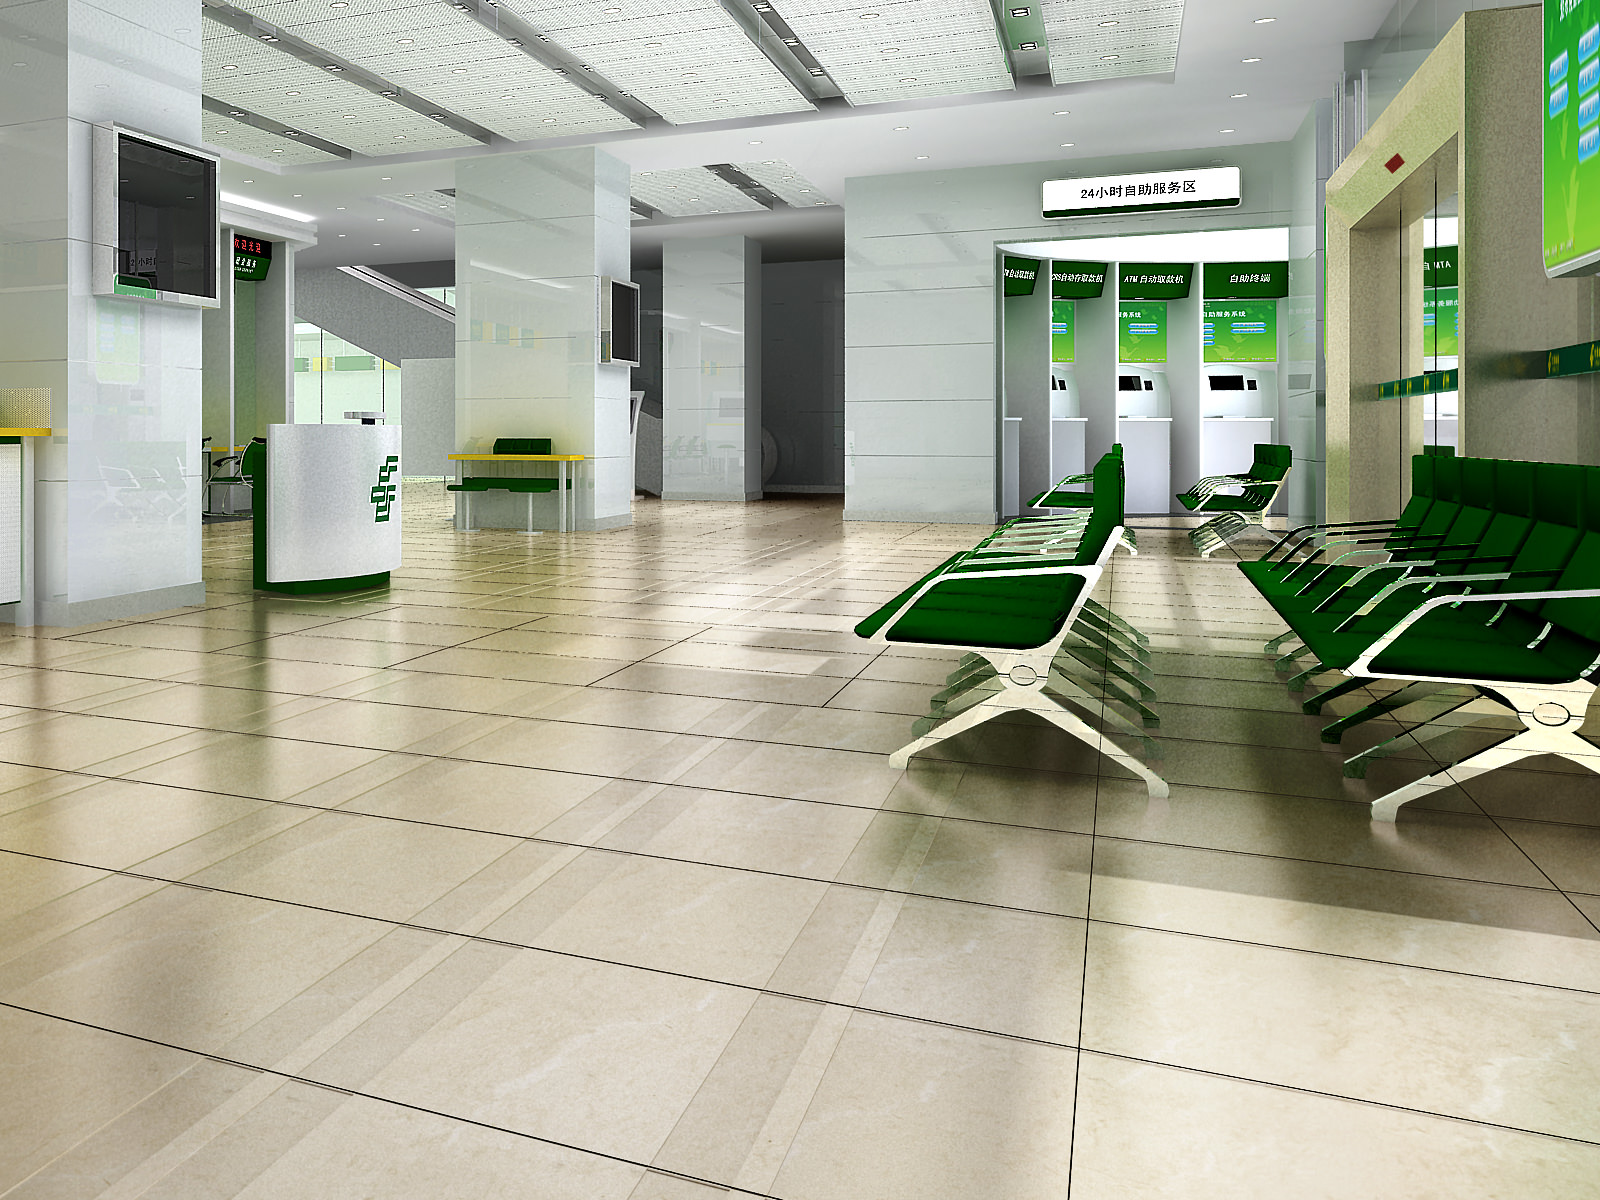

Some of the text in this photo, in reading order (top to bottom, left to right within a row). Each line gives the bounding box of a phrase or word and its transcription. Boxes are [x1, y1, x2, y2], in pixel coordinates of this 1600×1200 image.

[1081, 180, 1196, 199] 24小时自助服务区
[1124, 275, 1139, 283] ATM
[1230, 273, 1271, 283] 自助终端
